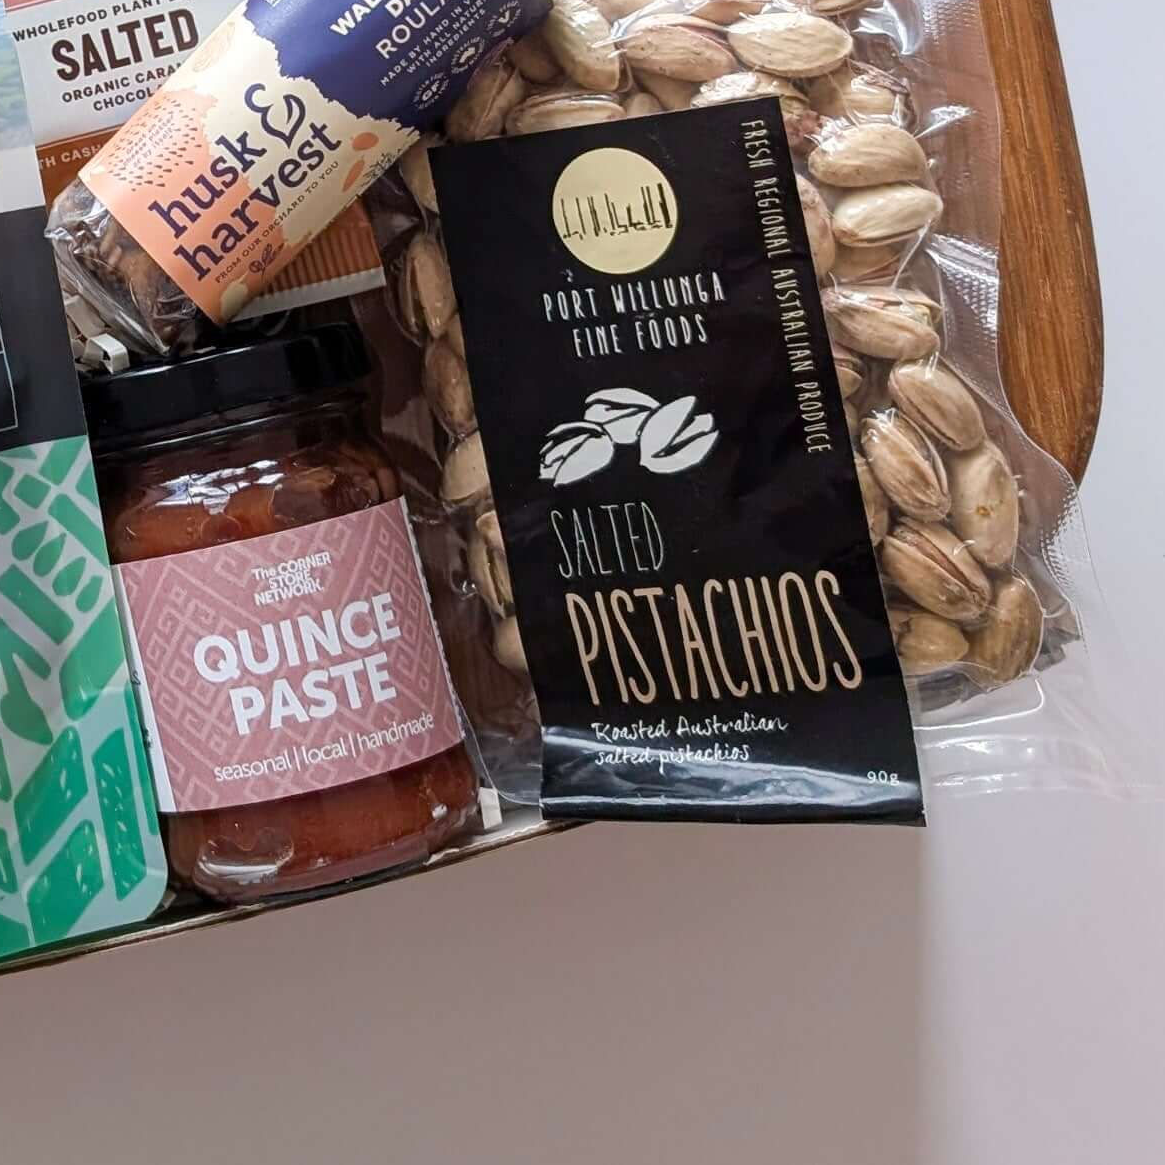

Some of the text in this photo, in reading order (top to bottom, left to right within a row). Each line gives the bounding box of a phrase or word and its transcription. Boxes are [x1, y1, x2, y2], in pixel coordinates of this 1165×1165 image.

[13, 10, 107, 42] WHOLEFOOD
[52, 8, 199, 81] SALTED
[381, 60, 408, 86] MADE
[409, 46, 420, 59] BY
[423, 19, 449, 44] HAND
[451, 6, 462, 18] IN
[407, 51, 432, 74] WITH
[434, 32, 451, 48] ALL
[427, 9, 486, 67] INGREDIENTS
[62, 63, 183, 103] ORGANIC CARA
[148, 131, 267, 238] husk
[173, 122, 341, 280] harvest
[216, 162, 339, 283] FROM OUR ORCHARD TO YOU
[543, 272, 726, 322] PORT WILLUNGA
[741, 119, 832, 454] FRESH REGIONAL AUSTRALIAN PRODUCE
[573, 314, 707, 357] FINE FOODS
[252, 552, 331, 581] The CORNER
[551, 501, 664, 578] SALTED
[268, 570, 311, 590] STORE
[193, 592, 401, 683] QUINCE
[566, 570, 862, 706] PISTACHIOS
[229, 651, 396, 735] PASTE
[214, 714, 434, 782] seasonal local handmade
[591, 712, 788, 742] Roasted Australian
[595, 743, 750, 775] salted pistachios
[867, 770, 900, 785] 90g
